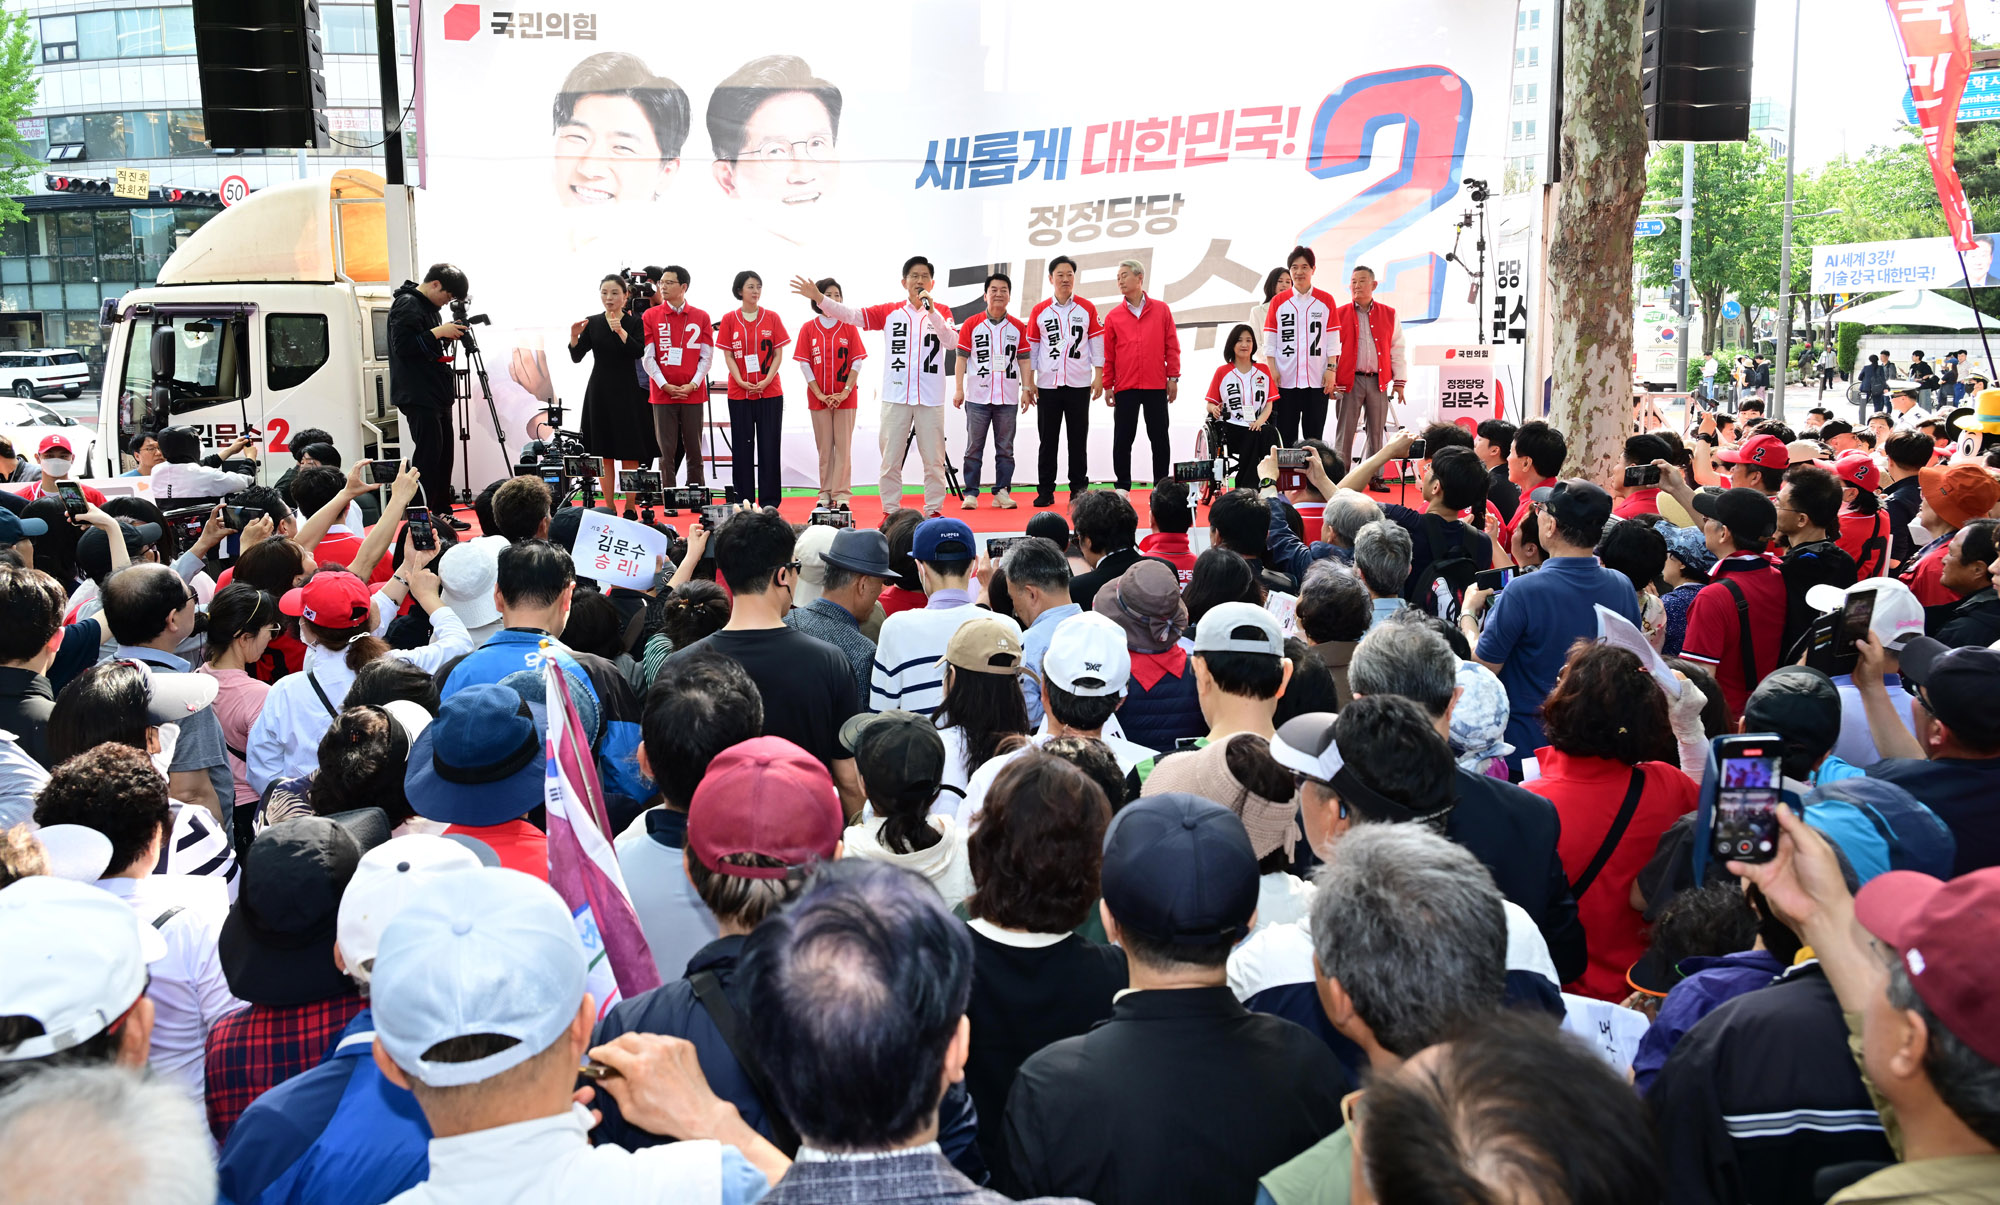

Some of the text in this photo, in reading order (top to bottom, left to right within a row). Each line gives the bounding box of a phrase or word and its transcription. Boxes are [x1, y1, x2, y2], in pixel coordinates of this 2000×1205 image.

[491, 11, 597, 41] 국민의힘
[914, 105, 1302, 191] 새롭게 대한민국!
[116, 183, 147, 198] 좌회전
[117, 169, 149, 184] 직진후
[226, 184, 244, 201] 50
[1296, 62, 1473, 330] 2
[1028, 192, 1186, 247] 정정당당
[1824, 250, 1896, 268] AI 세계 3강!
[1824, 267, 1936, 286] 기술 강국 대한민국!
[657, 323, 672, 366] 김문수
[685, 323, 701, 349] 2
[891, 322, 908, 372] 김문수
[1044, 318, 1061, 360] 김문수
[1068, 325, 1084, 359] 2
[1281, 313, 1295, 357] 김문수
[1310, 321, 1322, 357] 2
[760, 339, 773, 375] 2
[836, 346, 849, 383] 2
[923, 333, 941, 374] 2
[974, 333, 990, 379] 김문수
[1005, 343, 1017, 379] 2
[1458, 350, 1489, 358] 국민의힘
[1447, 379, 1485, 389] 정정당당
[1441, 391, 1489, 408] 김문수
[52, 435, 61, 444] 2
[190, 424, 263, 448] 김문수
[267, 418, 291, 453] 2
[1752, 447, 1766, 463] 2
[1854, 466, 1870, 480] 2
[598, 534, 646, 560] 김문수
[595, 553, 640, 577] 승 리!
